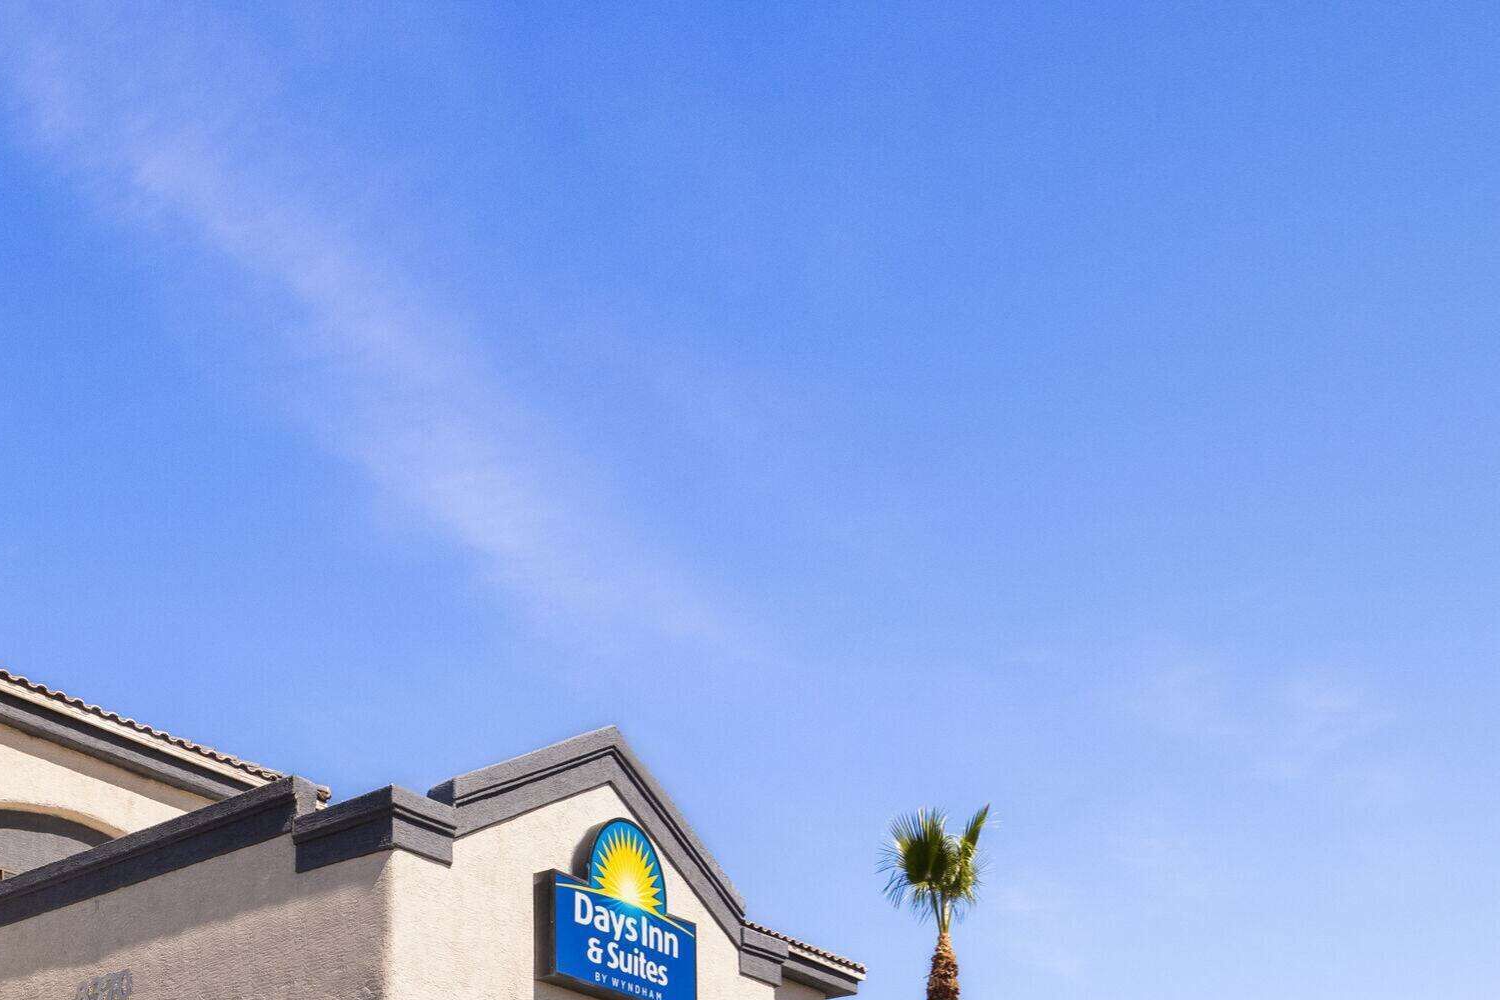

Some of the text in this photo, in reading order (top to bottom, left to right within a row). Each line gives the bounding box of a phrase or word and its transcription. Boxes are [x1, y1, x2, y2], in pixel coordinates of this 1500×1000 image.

[574, 891, 679, 959] Days Inn
[587, 937, 668, 986] & Suites
[595, 971, 662, 1000] BY WYNDHAM
